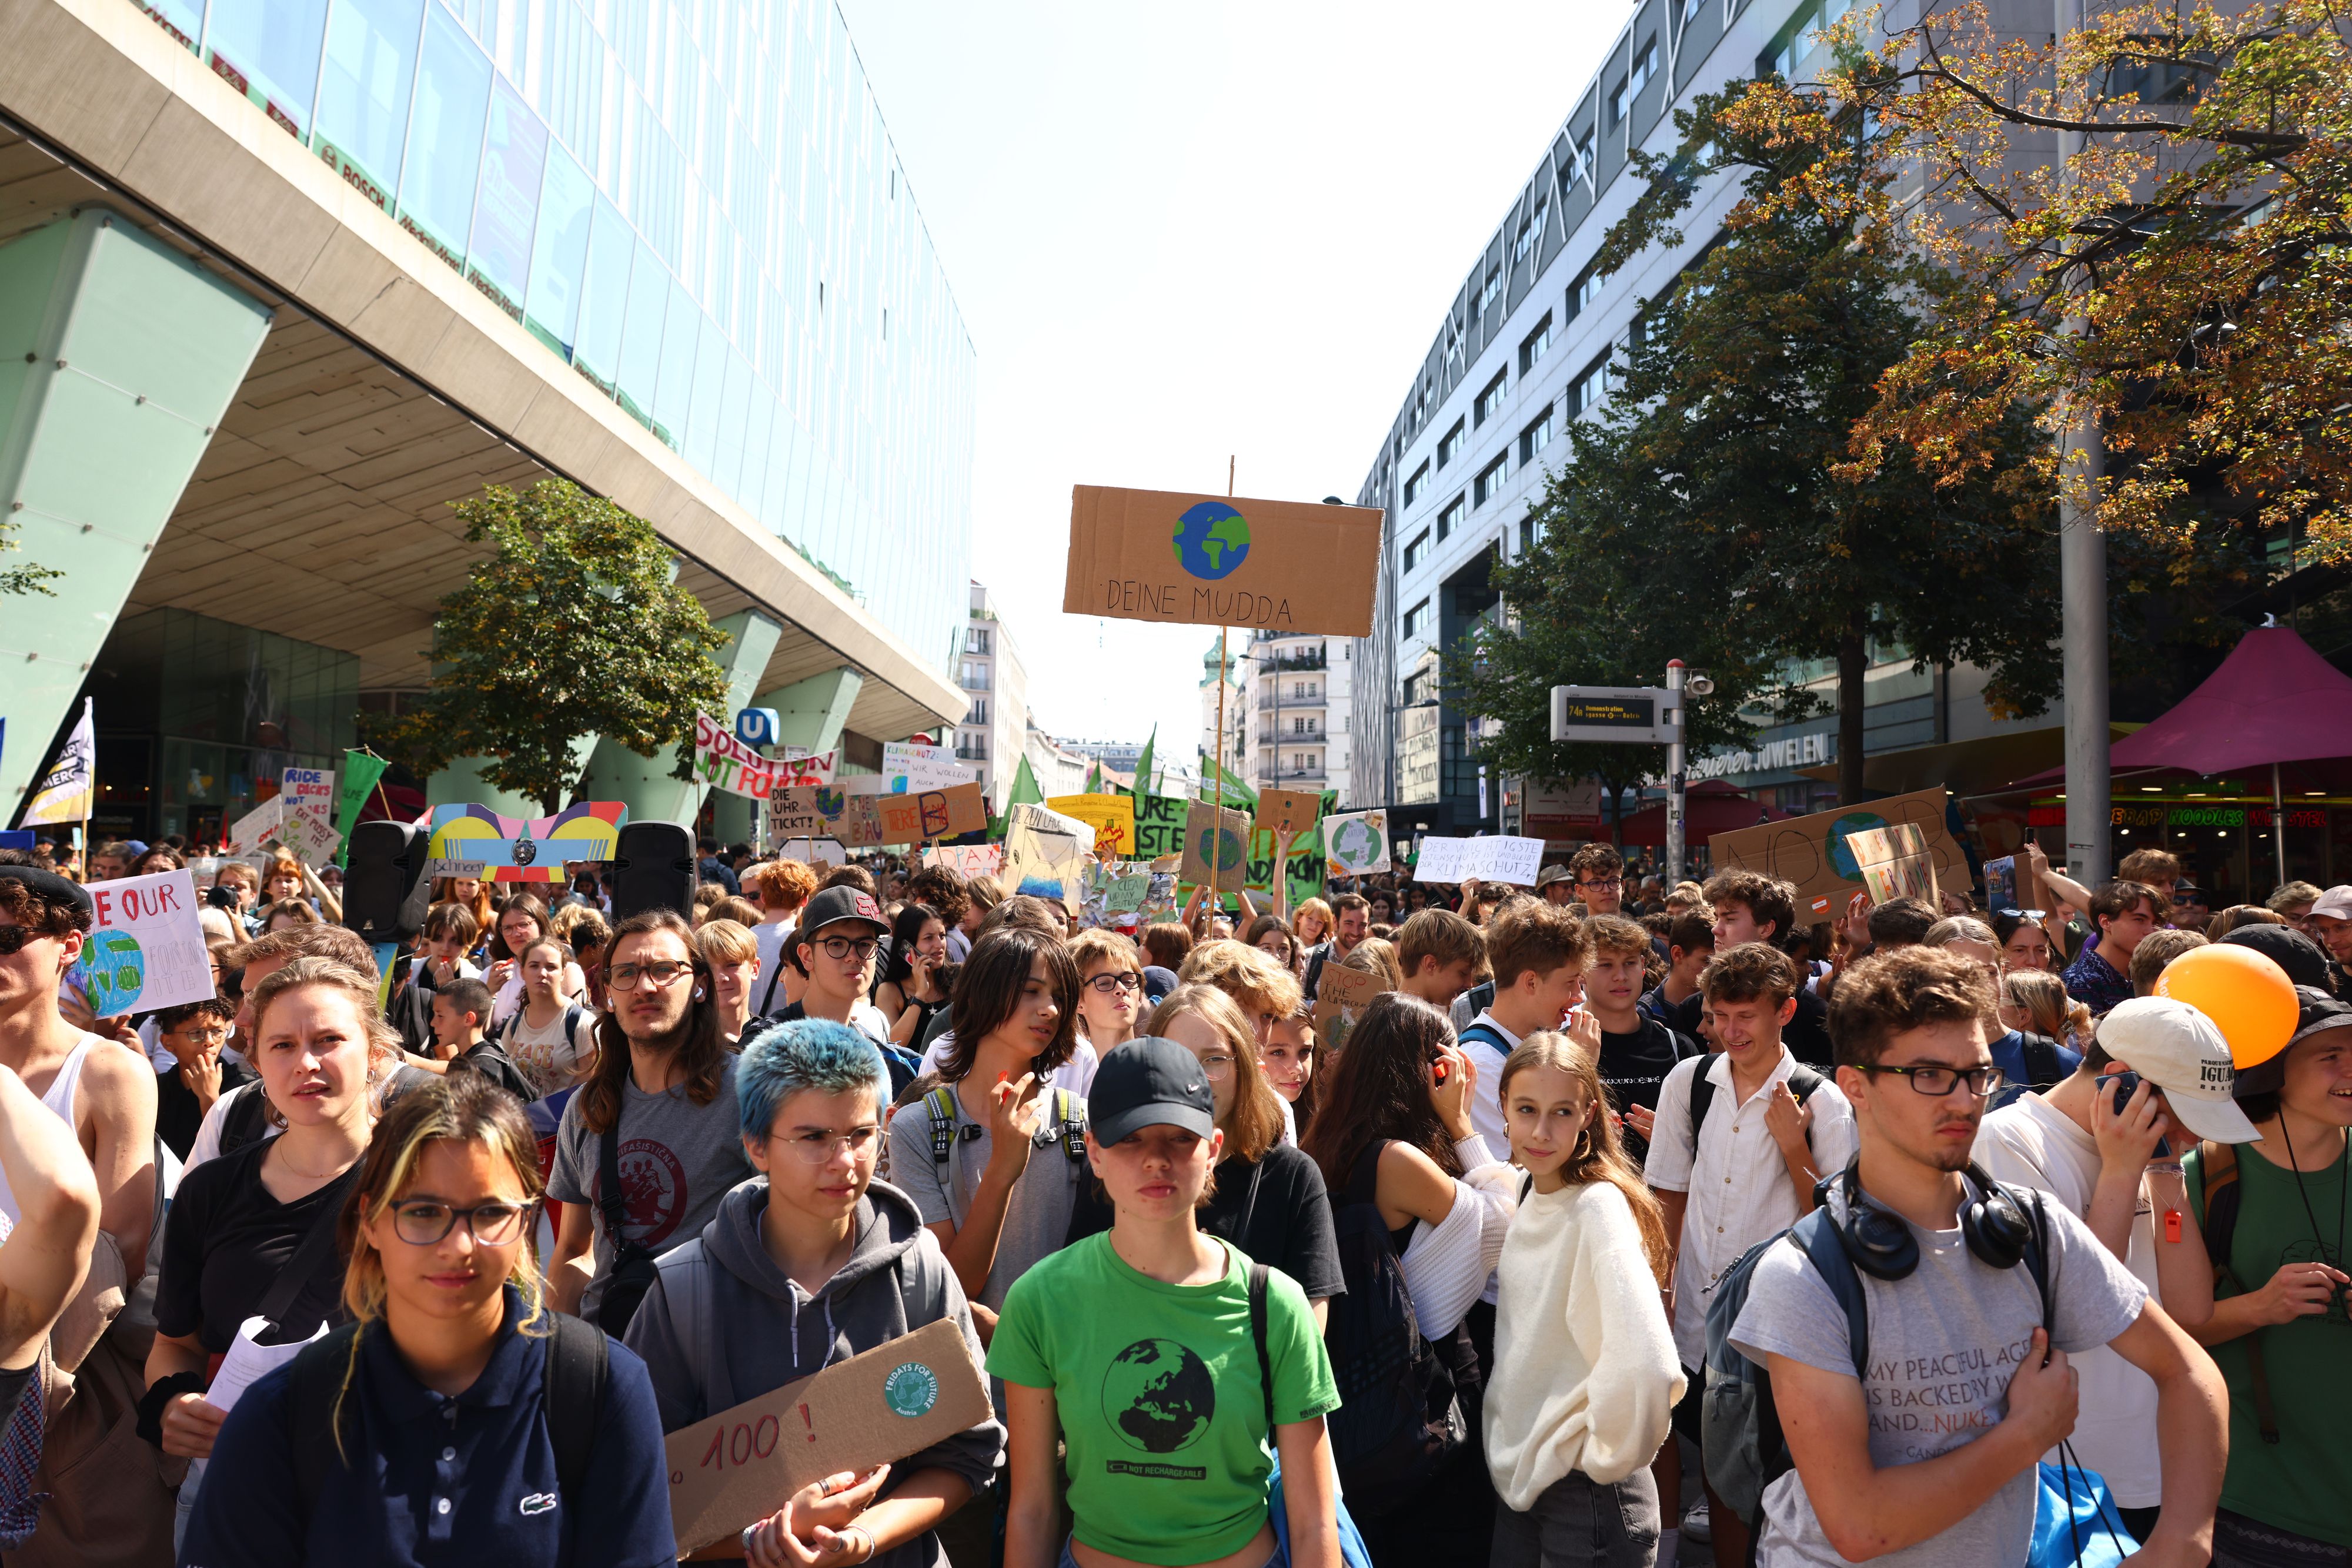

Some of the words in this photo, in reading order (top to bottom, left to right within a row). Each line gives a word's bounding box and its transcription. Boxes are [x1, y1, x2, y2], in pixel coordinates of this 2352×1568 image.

[343, 163, 385, 210] BOSCH
[1108, 580, 1177, 614] DEINE
[1193, 587, 1292, 624] MUDDA
[742, 716, 764, 739] U
[696, 717, 834, 780] SOLUTION
[1754, 733, 1829, 771] JUWELEN
[285, 769, 321, 783] RIDE
[695, 751, 739, 788] NOT
[912, 764, 928, 773] WIR
[936, 768, 969, 779] WOLLEN
[285, 796, 305, 805] NOT
[772, 789, 790, 801] DIE
[295, 807, 310, 821] EAT
[774, 801, 799, 814] UHR
[770, 816, 813, 830] TICKT!
[2167, 808, 2244, 827] NOODLES
[309, 818, 333, 841] PUSSY
[310, 835, 323, 848] ITS
[1425, 841, 1448, 852] DER
[1455, 840, 1541, 854] WICHTIGSTE
[1421, 852, 1479, 862] ARTENSCHUTZ
[1118, 878, 1147, 892] CLEAN
[122, 884, 181, 921] OUR
[1326, 968, 1367, 989] STOP
[1325, 982, 1351, 998] THE
[1633, 1076, 1661, 1084] DESIRE
[1865, 1361, 1897, 1381] MY
[886, 1363, 913, 1391] FRIDAYS
[914, 1364, 930, 1378] FOR
[923, 1376, 937, 1409] FUTURE
[1866, 1388, 1882, 1405] IS
[1891, 1382, 1972, 1407] BACKED
[896, 1406, 917, 1416] Austria
[700, 1413, 780, 1470] 100
[798, 1402, 816, 1443] !
[1128, 1465, 1144, 1474] NOT
[1145, 1466, 1203, 1479] RECHARGEABLE
